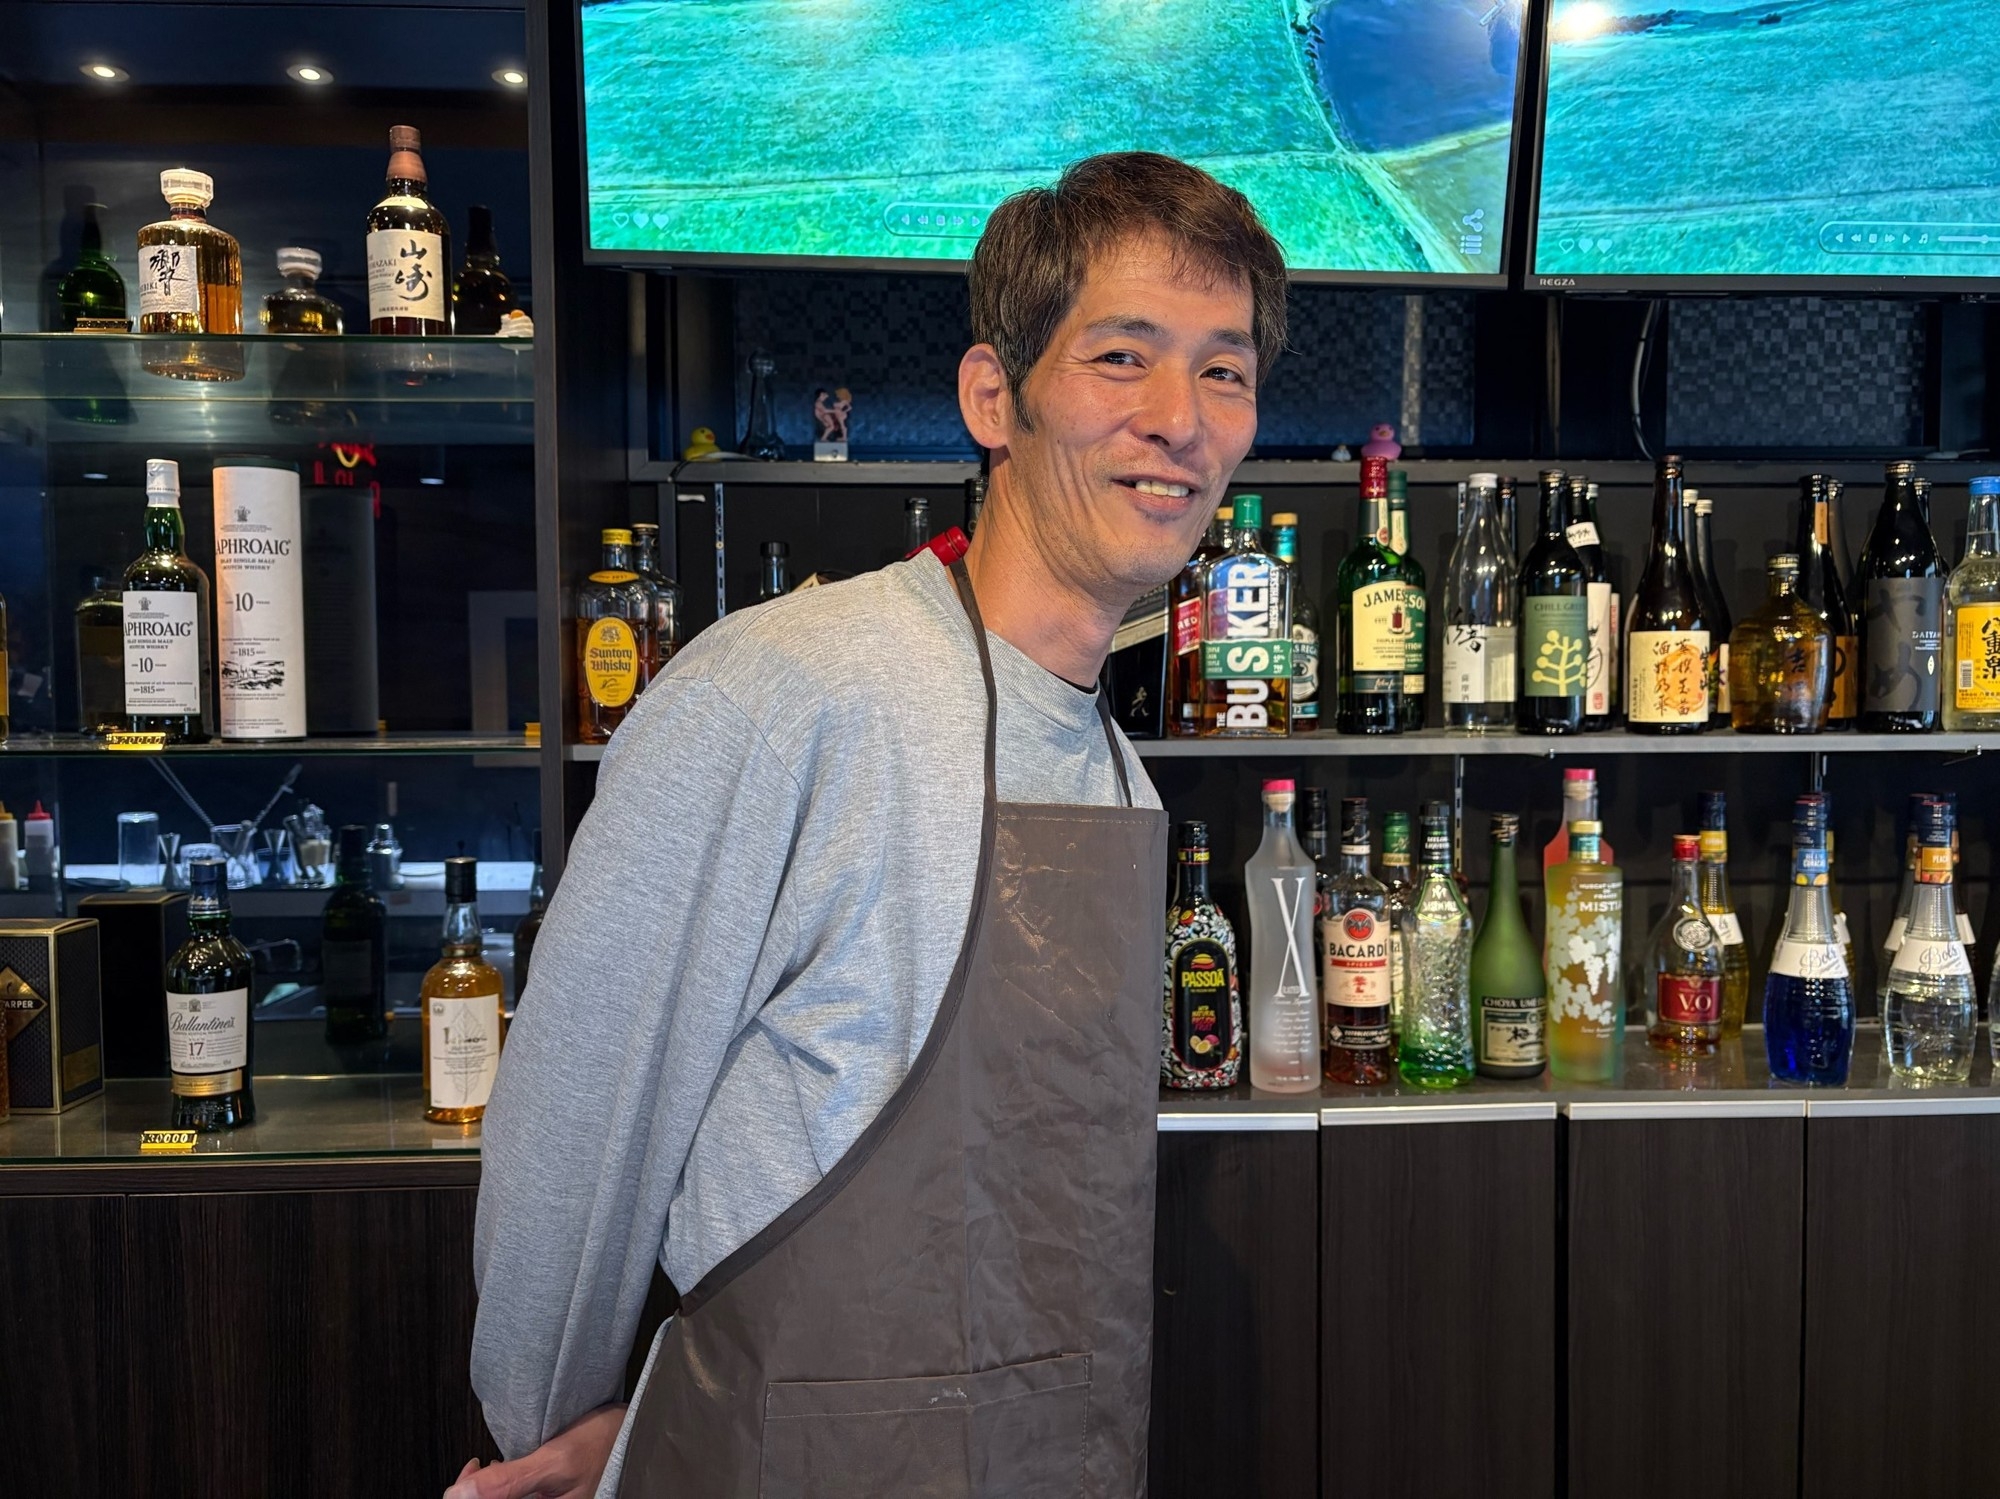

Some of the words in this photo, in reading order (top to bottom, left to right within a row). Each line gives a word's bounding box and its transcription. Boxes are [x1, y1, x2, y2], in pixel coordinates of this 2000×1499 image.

[149, 249, 189, 296] 響
[395, 239, 433, 302] 山崎
[1539, 278, 1576, 286] REGZA
[235, 592, 254, 612] 10
[1177, 616, 1198, 631] RED
[238, 647, 256, 656] 1815
[589, 647, 633, 660] Suntory
[1226, 563, 1270, 729] BUSKER
[138, 657, 154, 673] 10
[590, 660, 632, 673] Whisky
[139, 685, 156, 694] 1815
[1270, 877, 1310, 998] X
[1329, 940, 1388, 959] BACARDÍ
[1484, 998, 1518, 1008] CHOYA
[188, 1041, 205, 1057] 17
